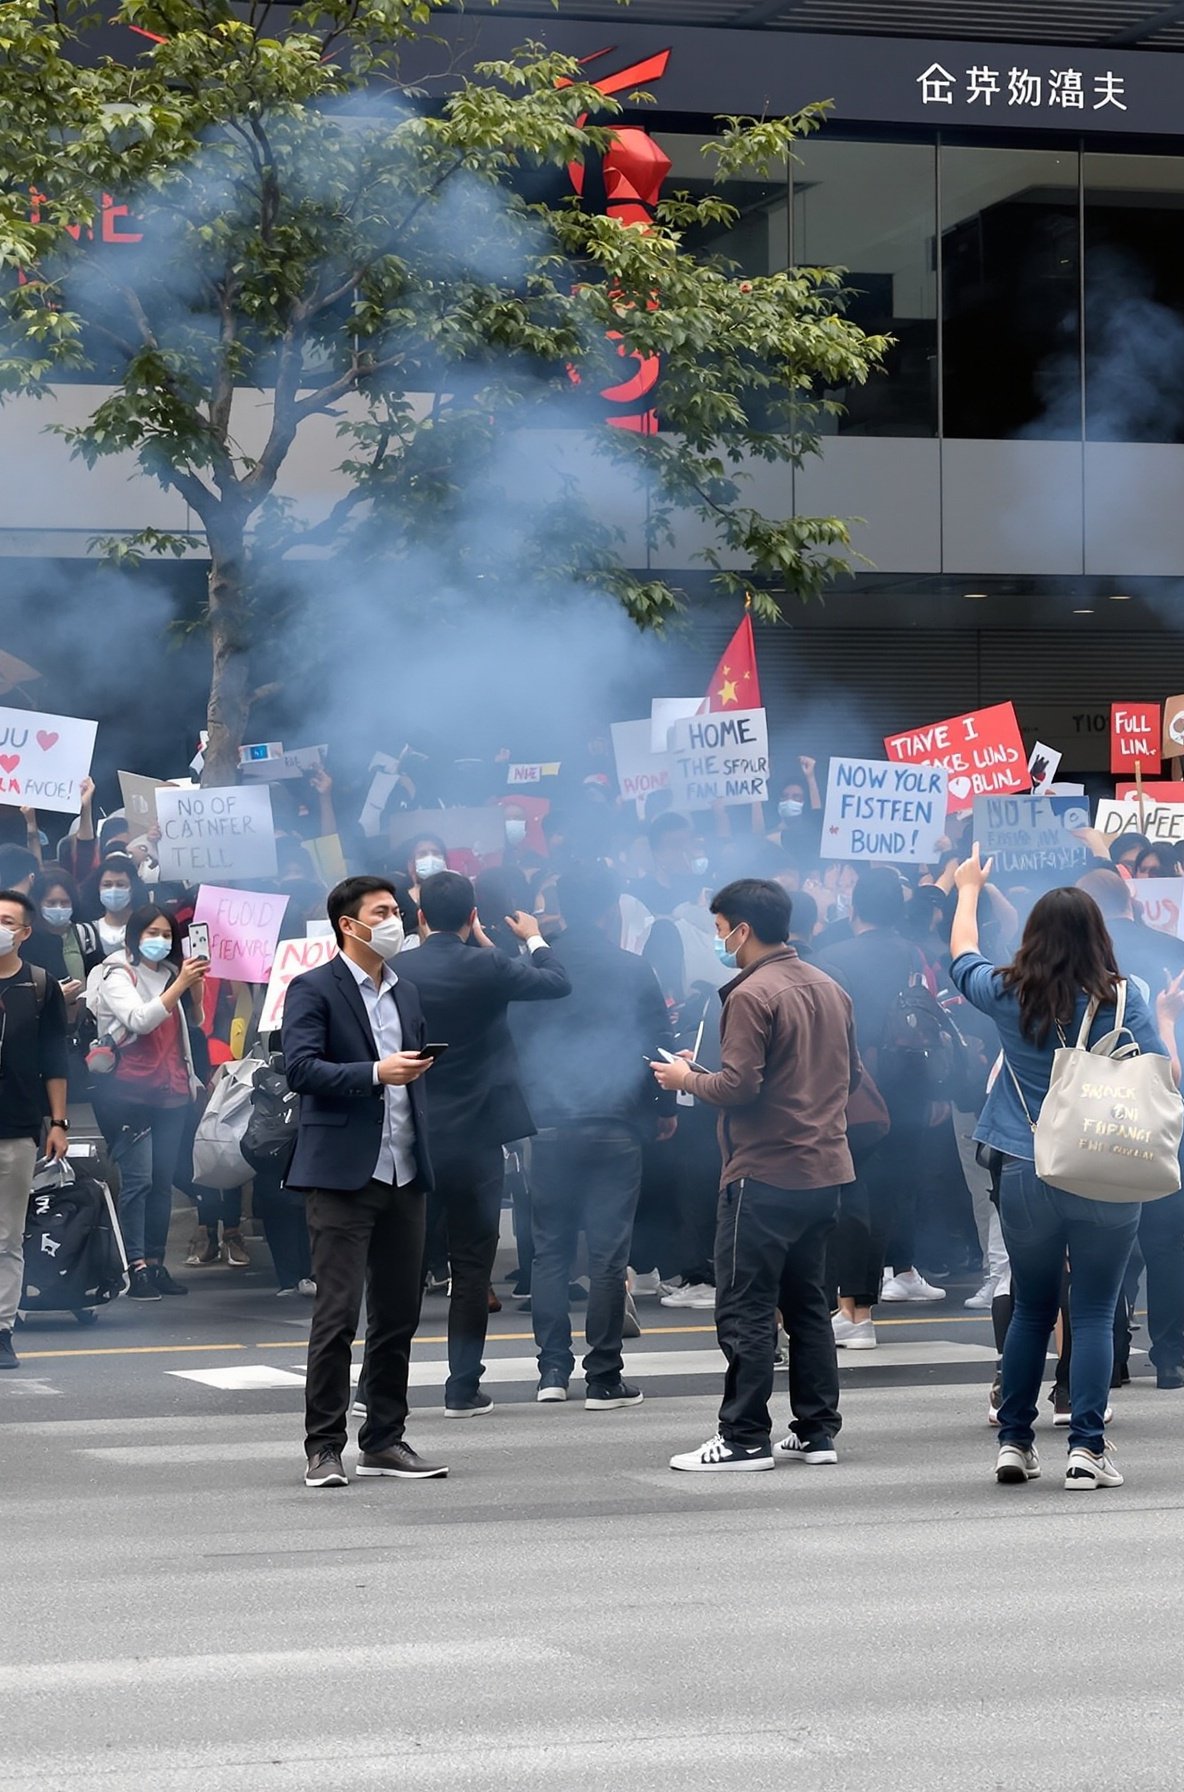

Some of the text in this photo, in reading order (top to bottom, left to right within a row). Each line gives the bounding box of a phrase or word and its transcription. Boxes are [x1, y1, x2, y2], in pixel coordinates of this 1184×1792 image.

[689, 718, 757, 749] HOME
[677, 756, 720, 777] THE
[836, 763, 887, 789] NOW
[178, 796, 236, 816] NO OF
[851, 830, 919, 854] BUND!
